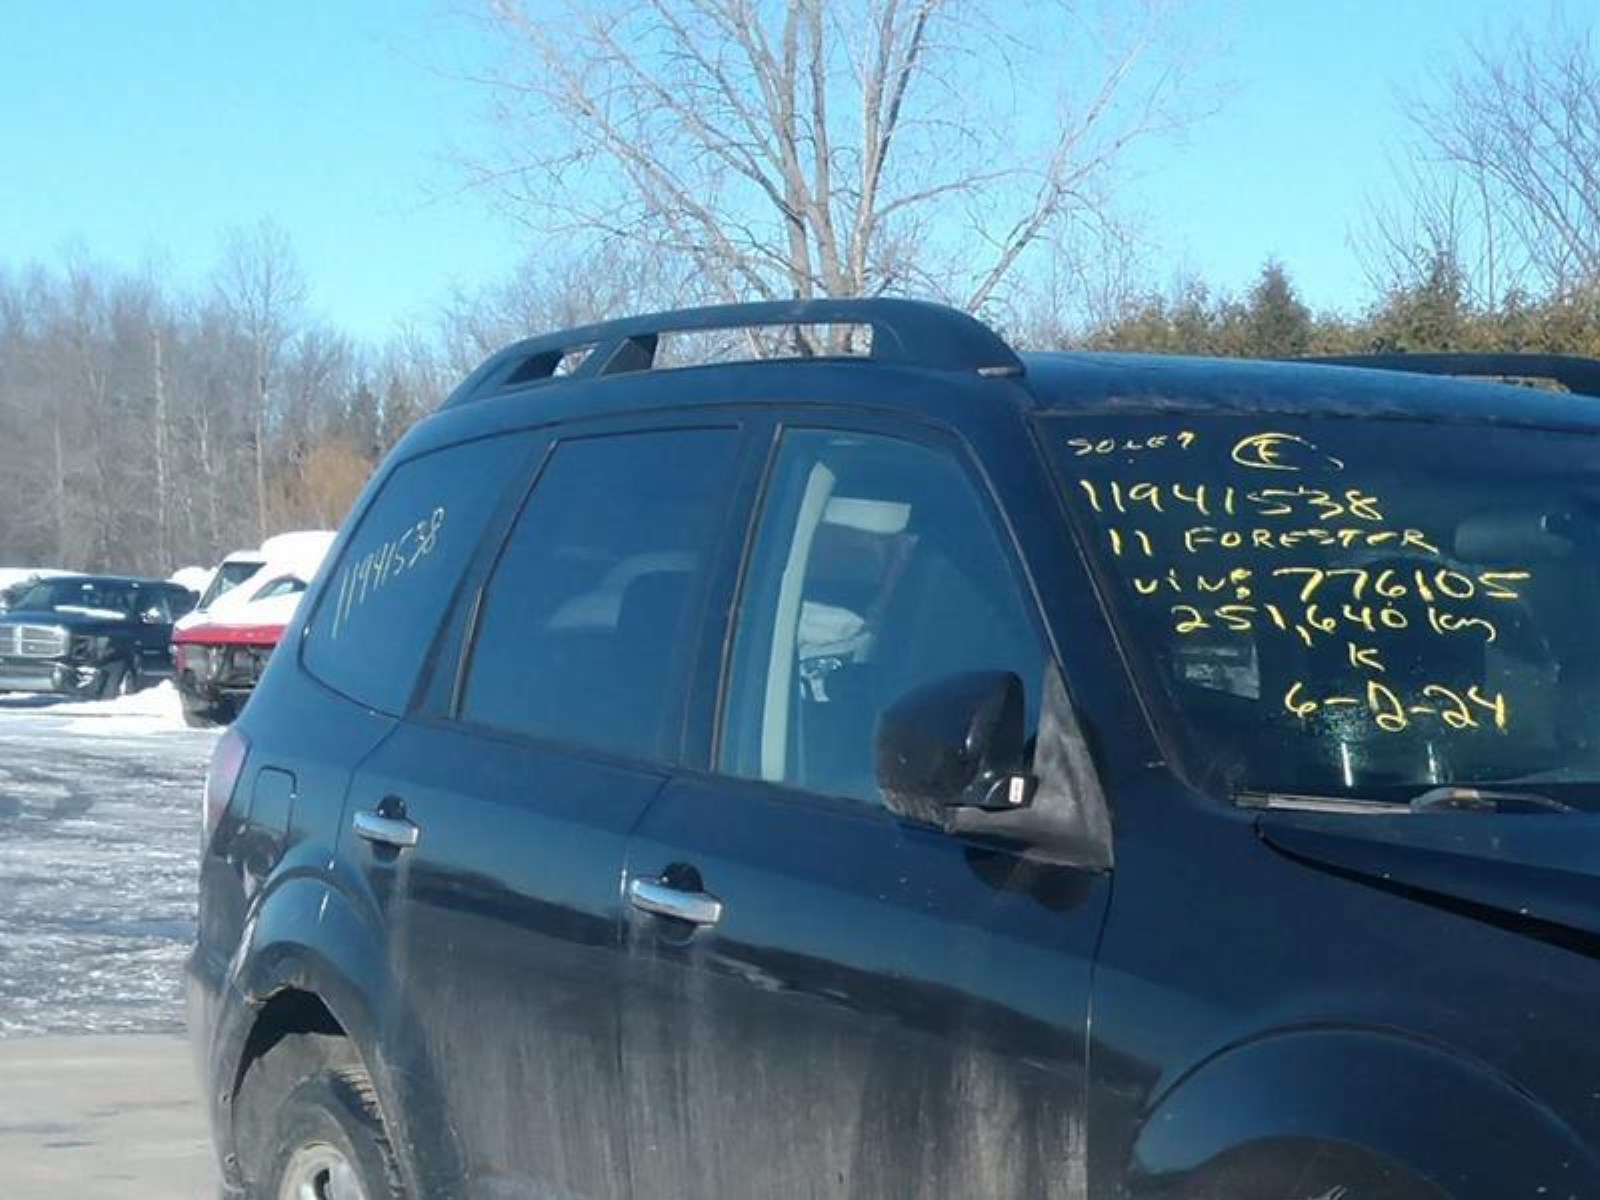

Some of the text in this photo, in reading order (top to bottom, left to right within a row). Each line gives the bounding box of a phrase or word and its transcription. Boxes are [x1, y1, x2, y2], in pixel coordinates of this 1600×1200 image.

[1079, 478, 1384, 522] 11941538
[1109, 526, 1440, 557] 11 FORESTER
[1272, 566, 1532, 603] 776105
[1171, 603, 1410, 647] 251,640
